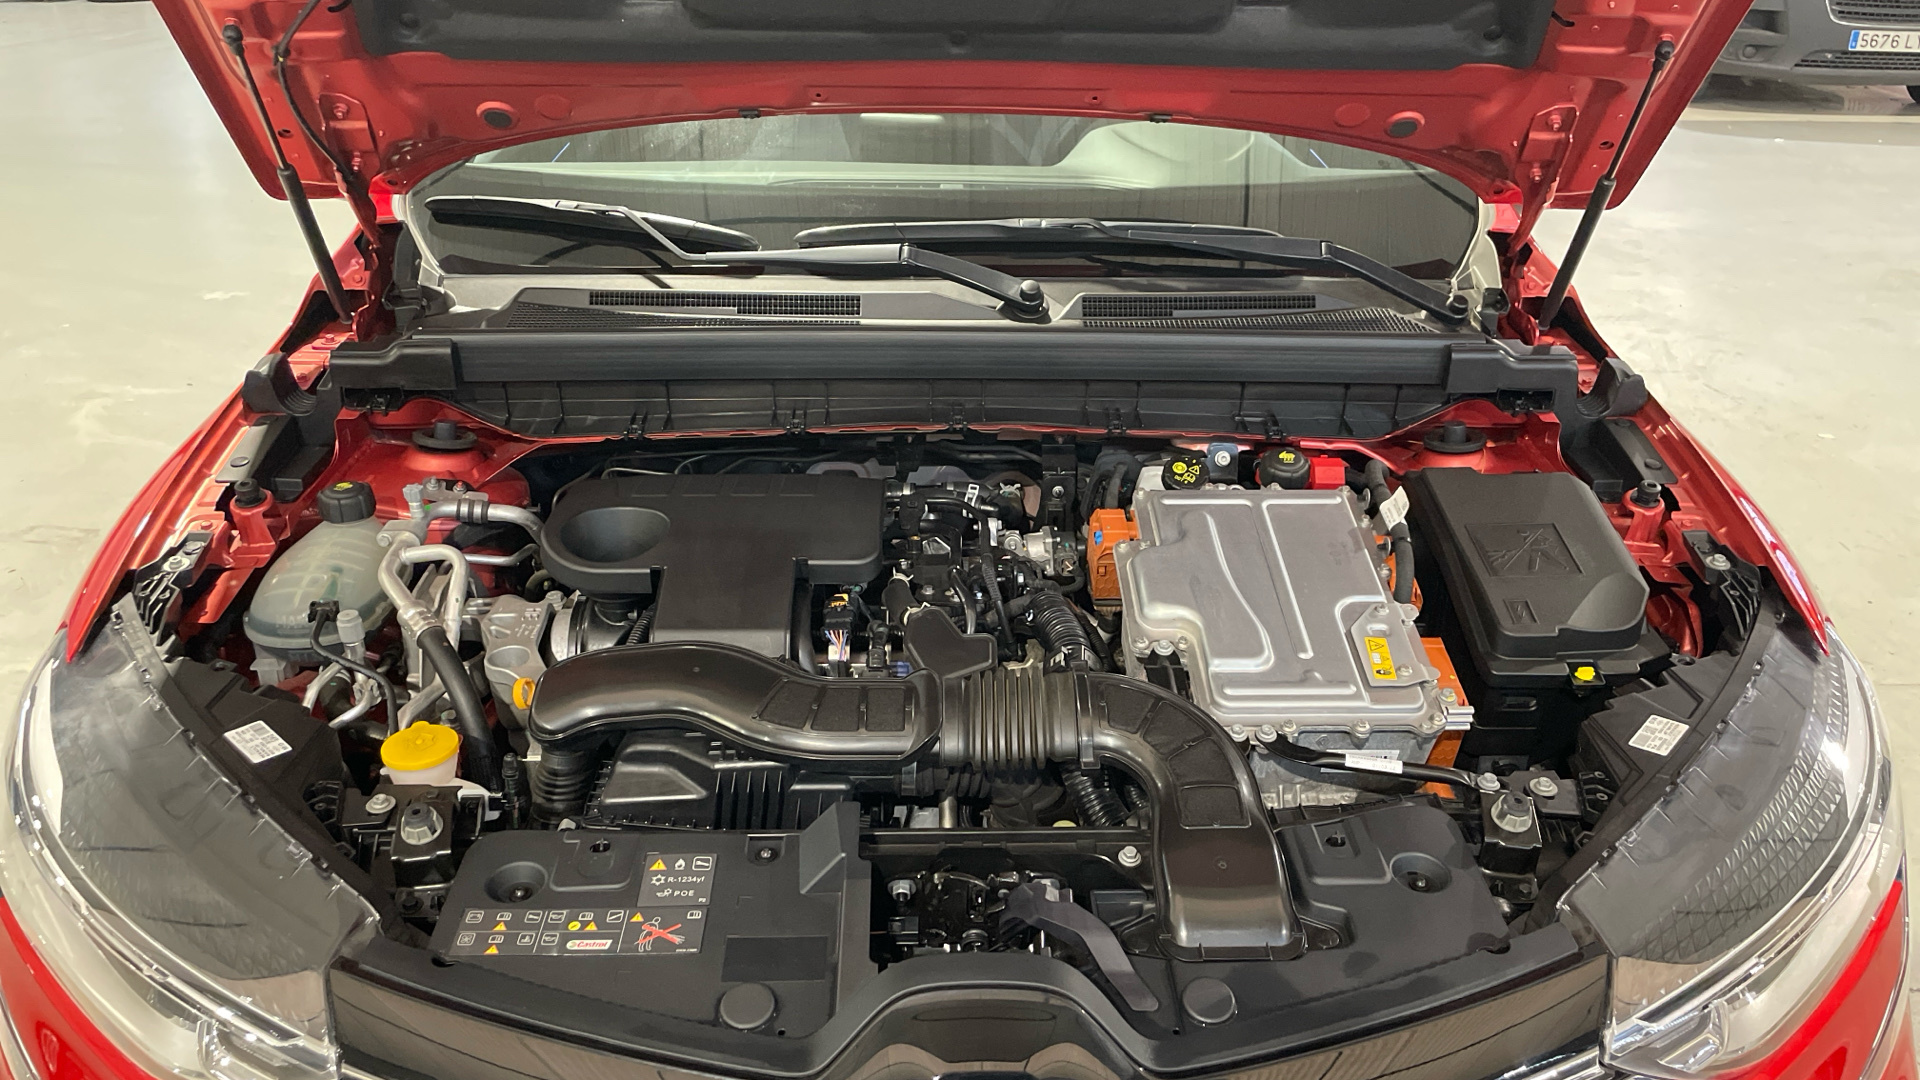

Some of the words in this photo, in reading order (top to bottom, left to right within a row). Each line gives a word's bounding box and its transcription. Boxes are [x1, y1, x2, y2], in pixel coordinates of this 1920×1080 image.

[1860, 33, 1900, 49] 5676
[1904, 34, 1920, 49] L
[667, 875, 705, 883] R-1234yf
[673, 889, 695, 897] POE
[576, 940, 609, 949] Castrol
